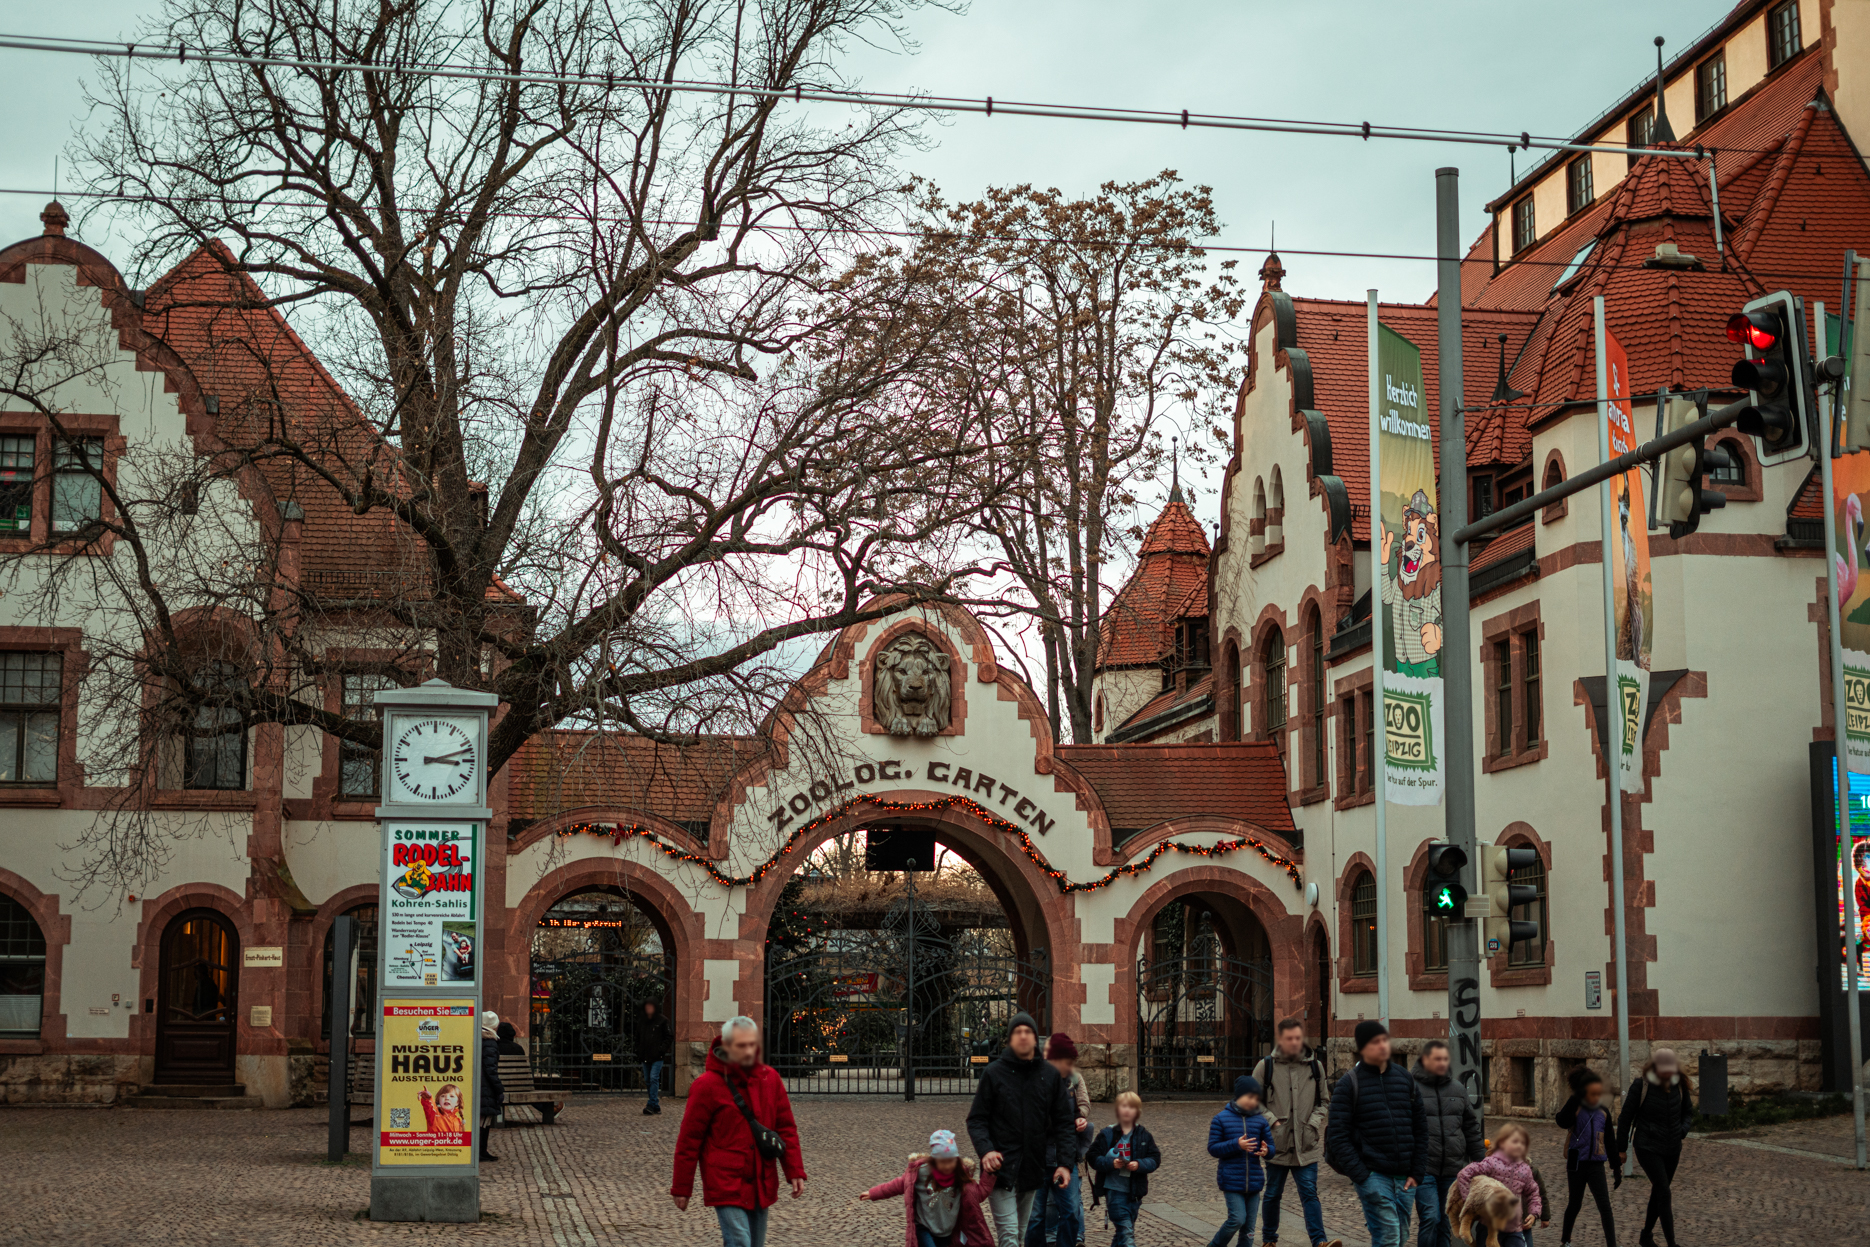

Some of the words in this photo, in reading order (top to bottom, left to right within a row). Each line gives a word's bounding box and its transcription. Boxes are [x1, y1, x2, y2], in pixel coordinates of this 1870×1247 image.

[1386, 374, 1418, 408] Herzlich
[1380, 409, 1432, 440] willkommen
[1846, 679, 1870, 706] ZO
[1385, 703, 1421, 732] ZOO
[1407, 776, 1416, 786] der
[1418, 776, 1438, 790] Spur.
[768, 760, 912, 832] ZOOLOG.
[928, 762, 1055, 836] GARTEN
[394, 830, 460, 841] SOMMER
[393, 843, 470, 867] RODEL-
[425, 873, 472, 892] BAHN
[392, 899, 468, 908] Kohren-Sahlis
[393, 1007, 434, 1015] Besuchen
[436, 1007, 450, 1015] Sie
[392, 1045, 464, 1053] MUSTER
[392, 1055, 464, 1073] HAUS
